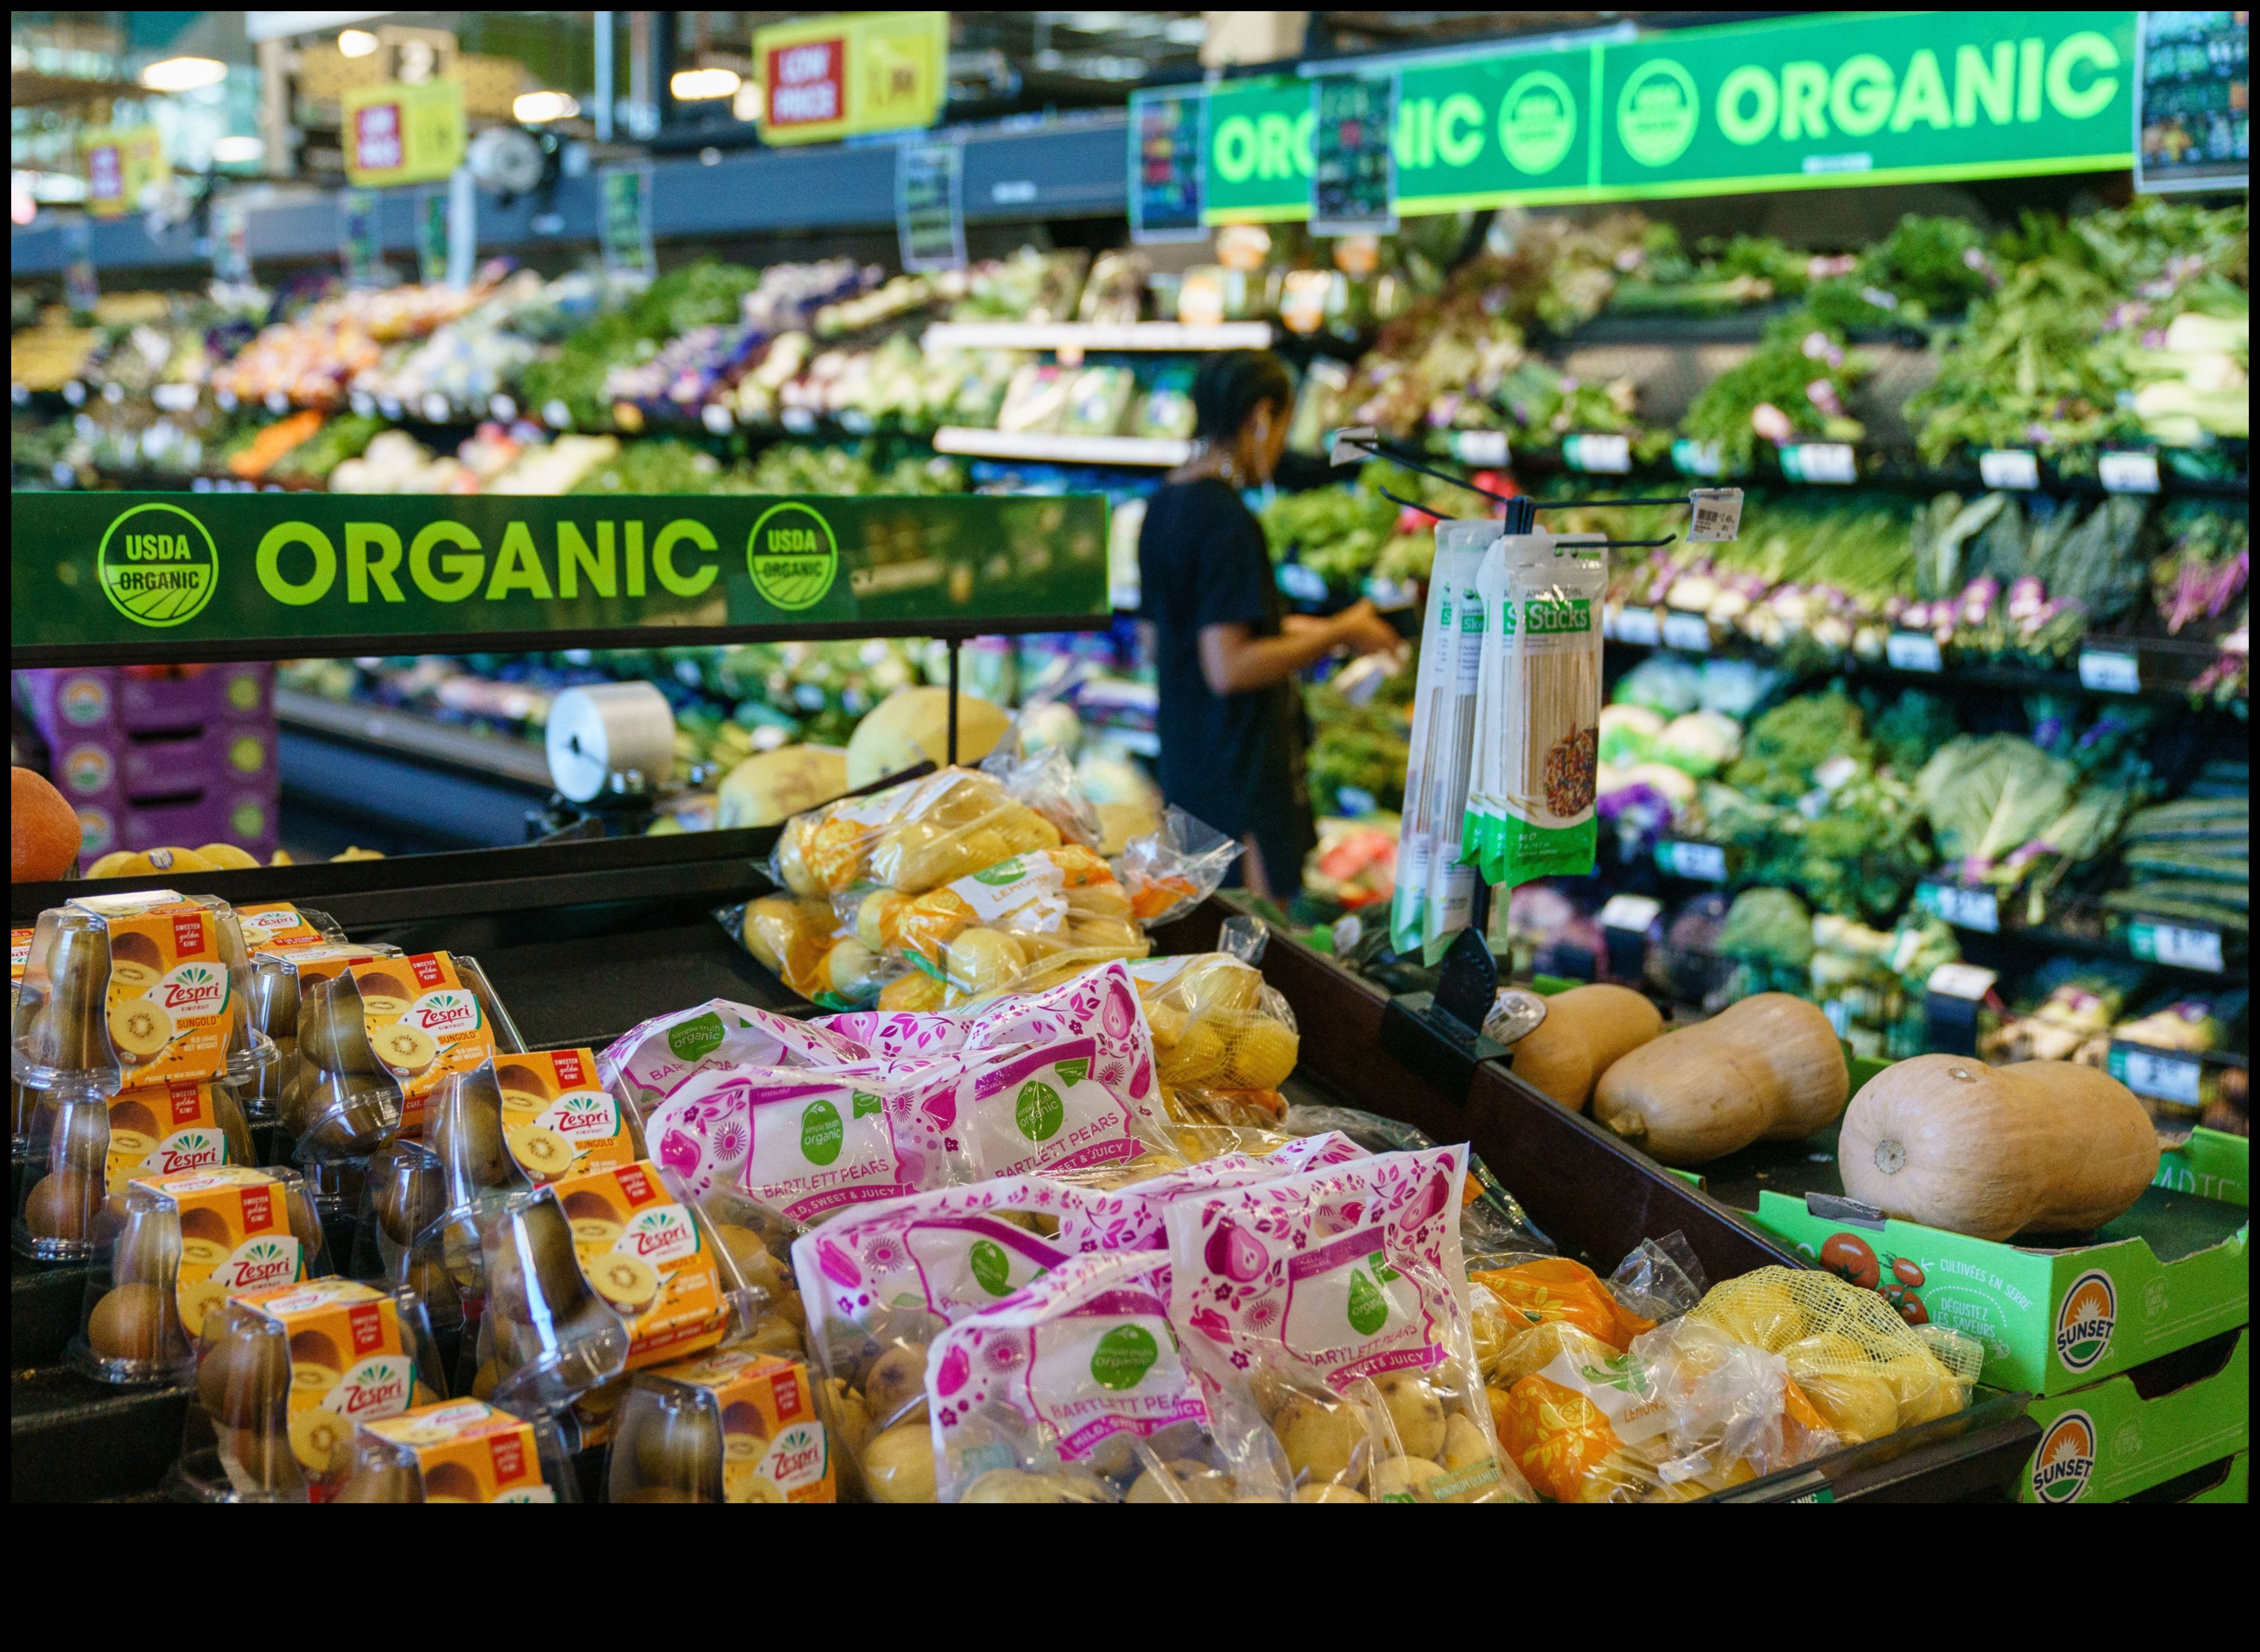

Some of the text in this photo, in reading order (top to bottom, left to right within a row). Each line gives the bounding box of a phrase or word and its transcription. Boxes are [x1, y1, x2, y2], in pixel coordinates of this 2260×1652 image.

[778, 44, 832, 83] LOW
[1714, 30, 2122, 147] ORGANIC
[1212, 91, 1487, 183] ORGNIC
[125, 534, 191, 560] USDA
[766, 529, 817, 552] USDA
[255, 518, 720, 606] ORGANIC
[763, 561, 822, 577] ORGANIC
[119, 571, 200, 590] ORGANIC
[1529, 601, 1588, 630] Sticks
[175, 923, 201, 931] SWEETER
[253, 915, 295, 926] Zespri
[179, 930, 200, 942] golden
[412, 959, 437, 968] SWEETER
[418, 967, 437, 977] golden
[163, 982, 223, 1008] Zespri
[416, 1005, 474, 1029] Zespri
[674, 1031, 720, 1049] organic
[559, 1065, 579, 1076] golden
[171, 1090, 197, 1099] SWEETER
[175, 1098, 196, 1110] golden
[554, 1109, 614, 1132] Zespri
[805, 1119, 840, 1134] simple truth
[1020, 1101, 1059, 1127] organic
[804, 1128, 841, 1146] organic
[1068, 1112, 1119, 1146] PEARS
[161, 1147, 219, 1174] Zespri
[1080, 1155, 1088, 1164] &
[1090, 1143, 1124, 1160] JUICY
[763, 1159, 889, 1198] BARTLETT PEARS
[811, 1194, 847, 1210] SWEET
[850, 1191, 858, 1199] &
[861, 1188, 896, 1198] JUICY
[630, 1222, 691, 1255] Zespri
[233, 1257, 293, 1287] Zespri
[1940, 1258, 2033, 1312] CULTIVÉES EN SERRE
[1941, 1297, 1988, 1321] DÉGUSTEZ
[1933, 1309, 1995, 1338] LES SAVEURS
[2056, 1319, 2115, 1352] SUNSET
[1390, 1352, 1424, 1366] JUICY
[345, 1378, 402, 1413] Zespri
[1623, 1395, 1668, 1424] LEMONS
[771, 1443, 821, 1481] Zespri
[2033, 1459, 2094, 1491] SUNSET
